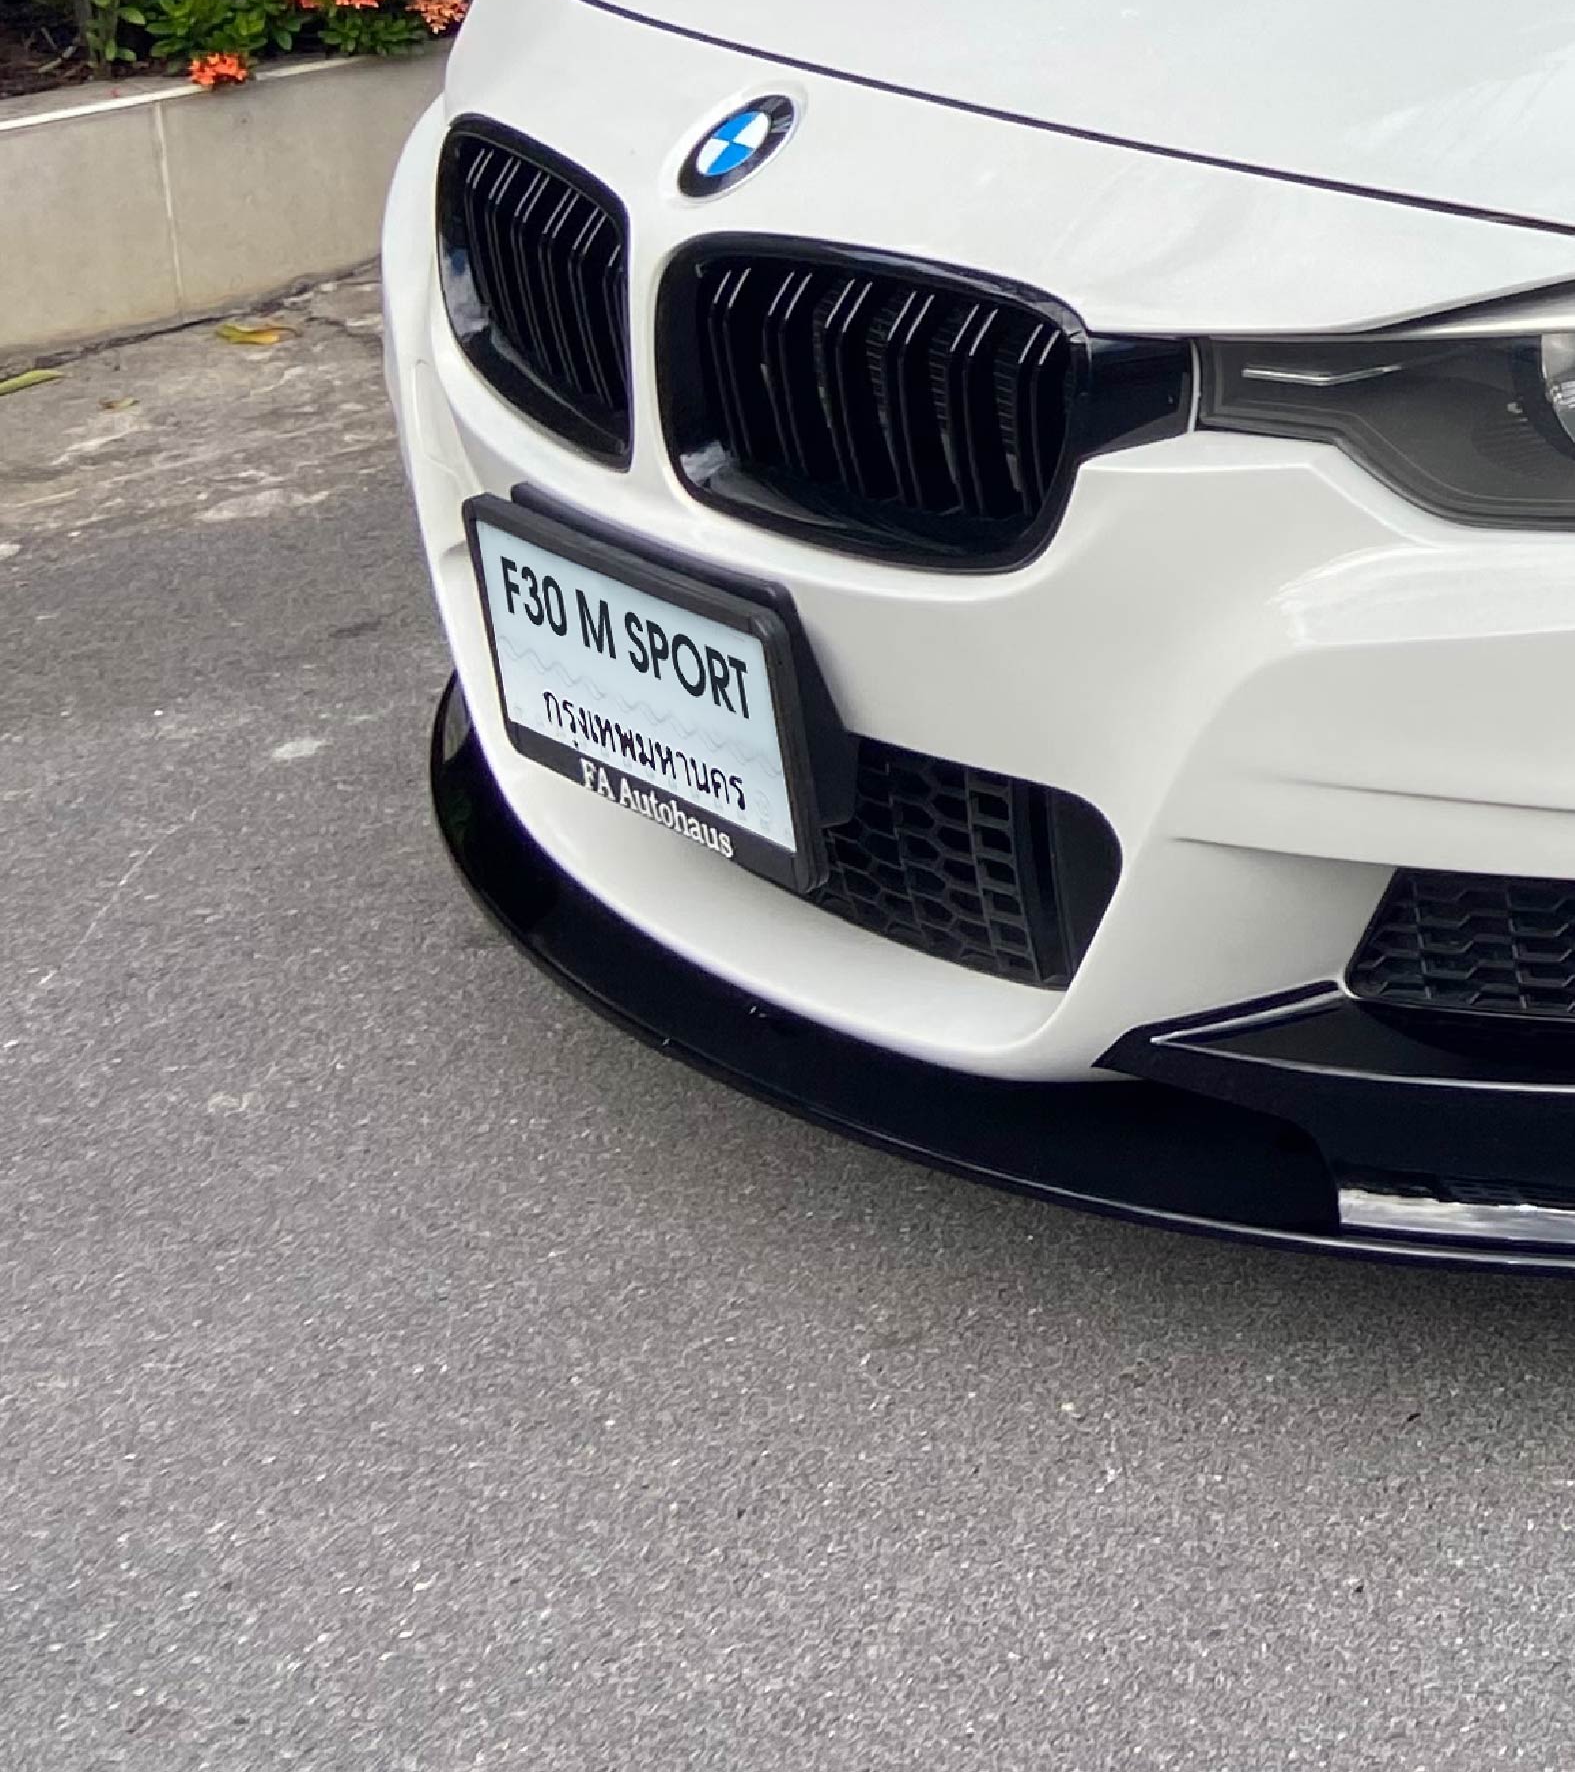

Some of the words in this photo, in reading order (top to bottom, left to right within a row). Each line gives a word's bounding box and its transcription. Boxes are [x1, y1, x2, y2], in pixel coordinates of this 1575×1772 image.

[500, 555, 567, 636] F30
[575, 589, 616, 659] M
[624, 611, 749, 719] SPORT
[543, 691, 746, 810] กรุงเทพมหานคร
[619, 778, 734, 859] Autohaus
